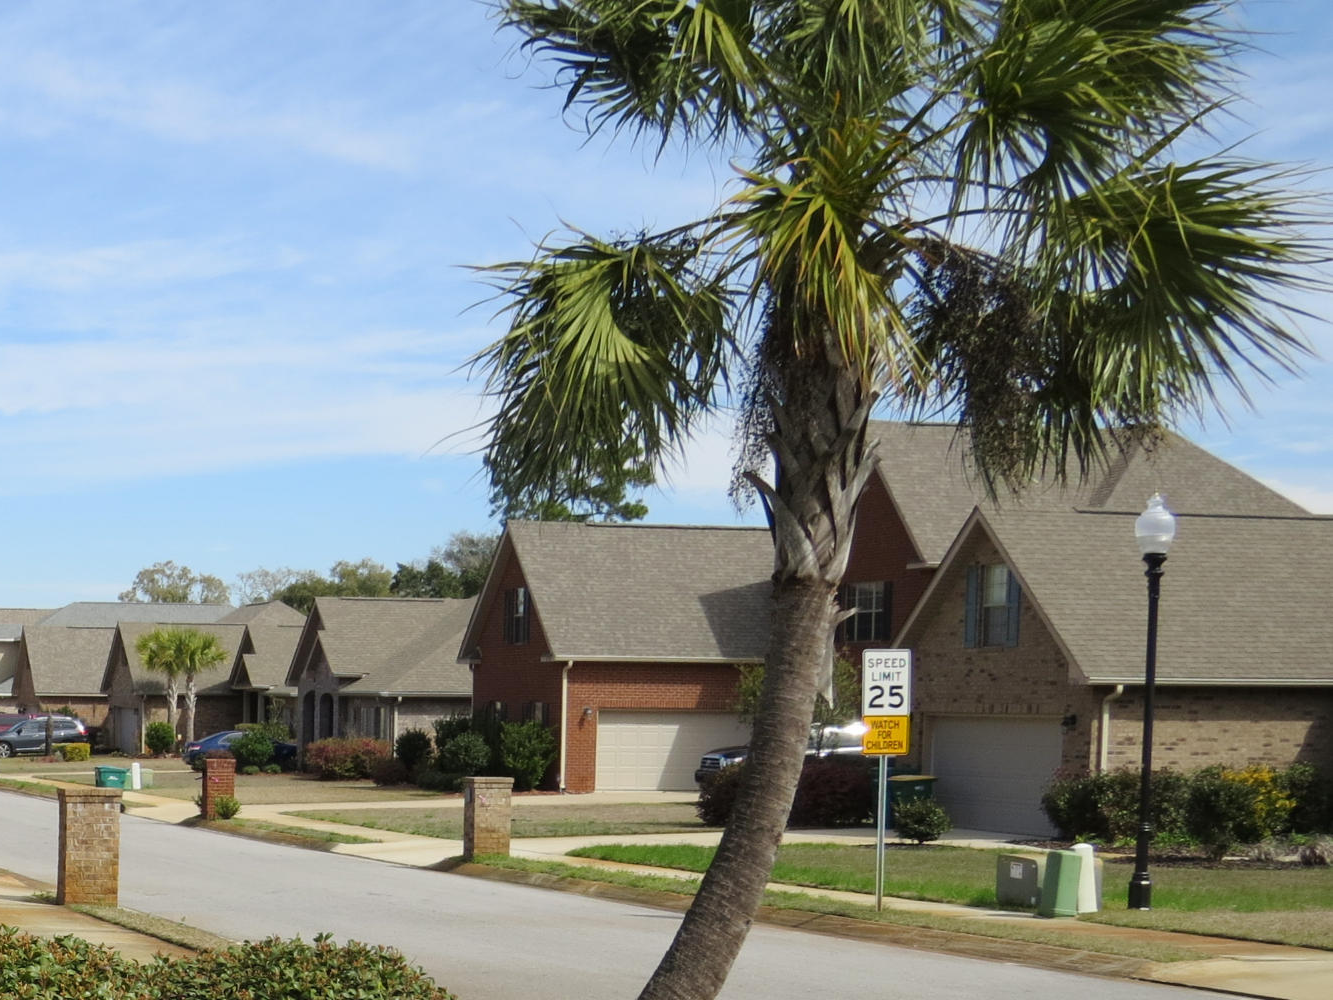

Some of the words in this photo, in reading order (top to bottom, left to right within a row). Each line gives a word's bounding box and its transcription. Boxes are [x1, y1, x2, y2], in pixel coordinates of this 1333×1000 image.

[867, 658, 906, 668] SPEED
[871, 671, 902, 681] LIMIT
[868, 685, 905, 708] 25
[871, 720, 900, 729] WATCH
[877, 731, 892, 739] FOR
[866, 740, 904, 750] CHILDREN
